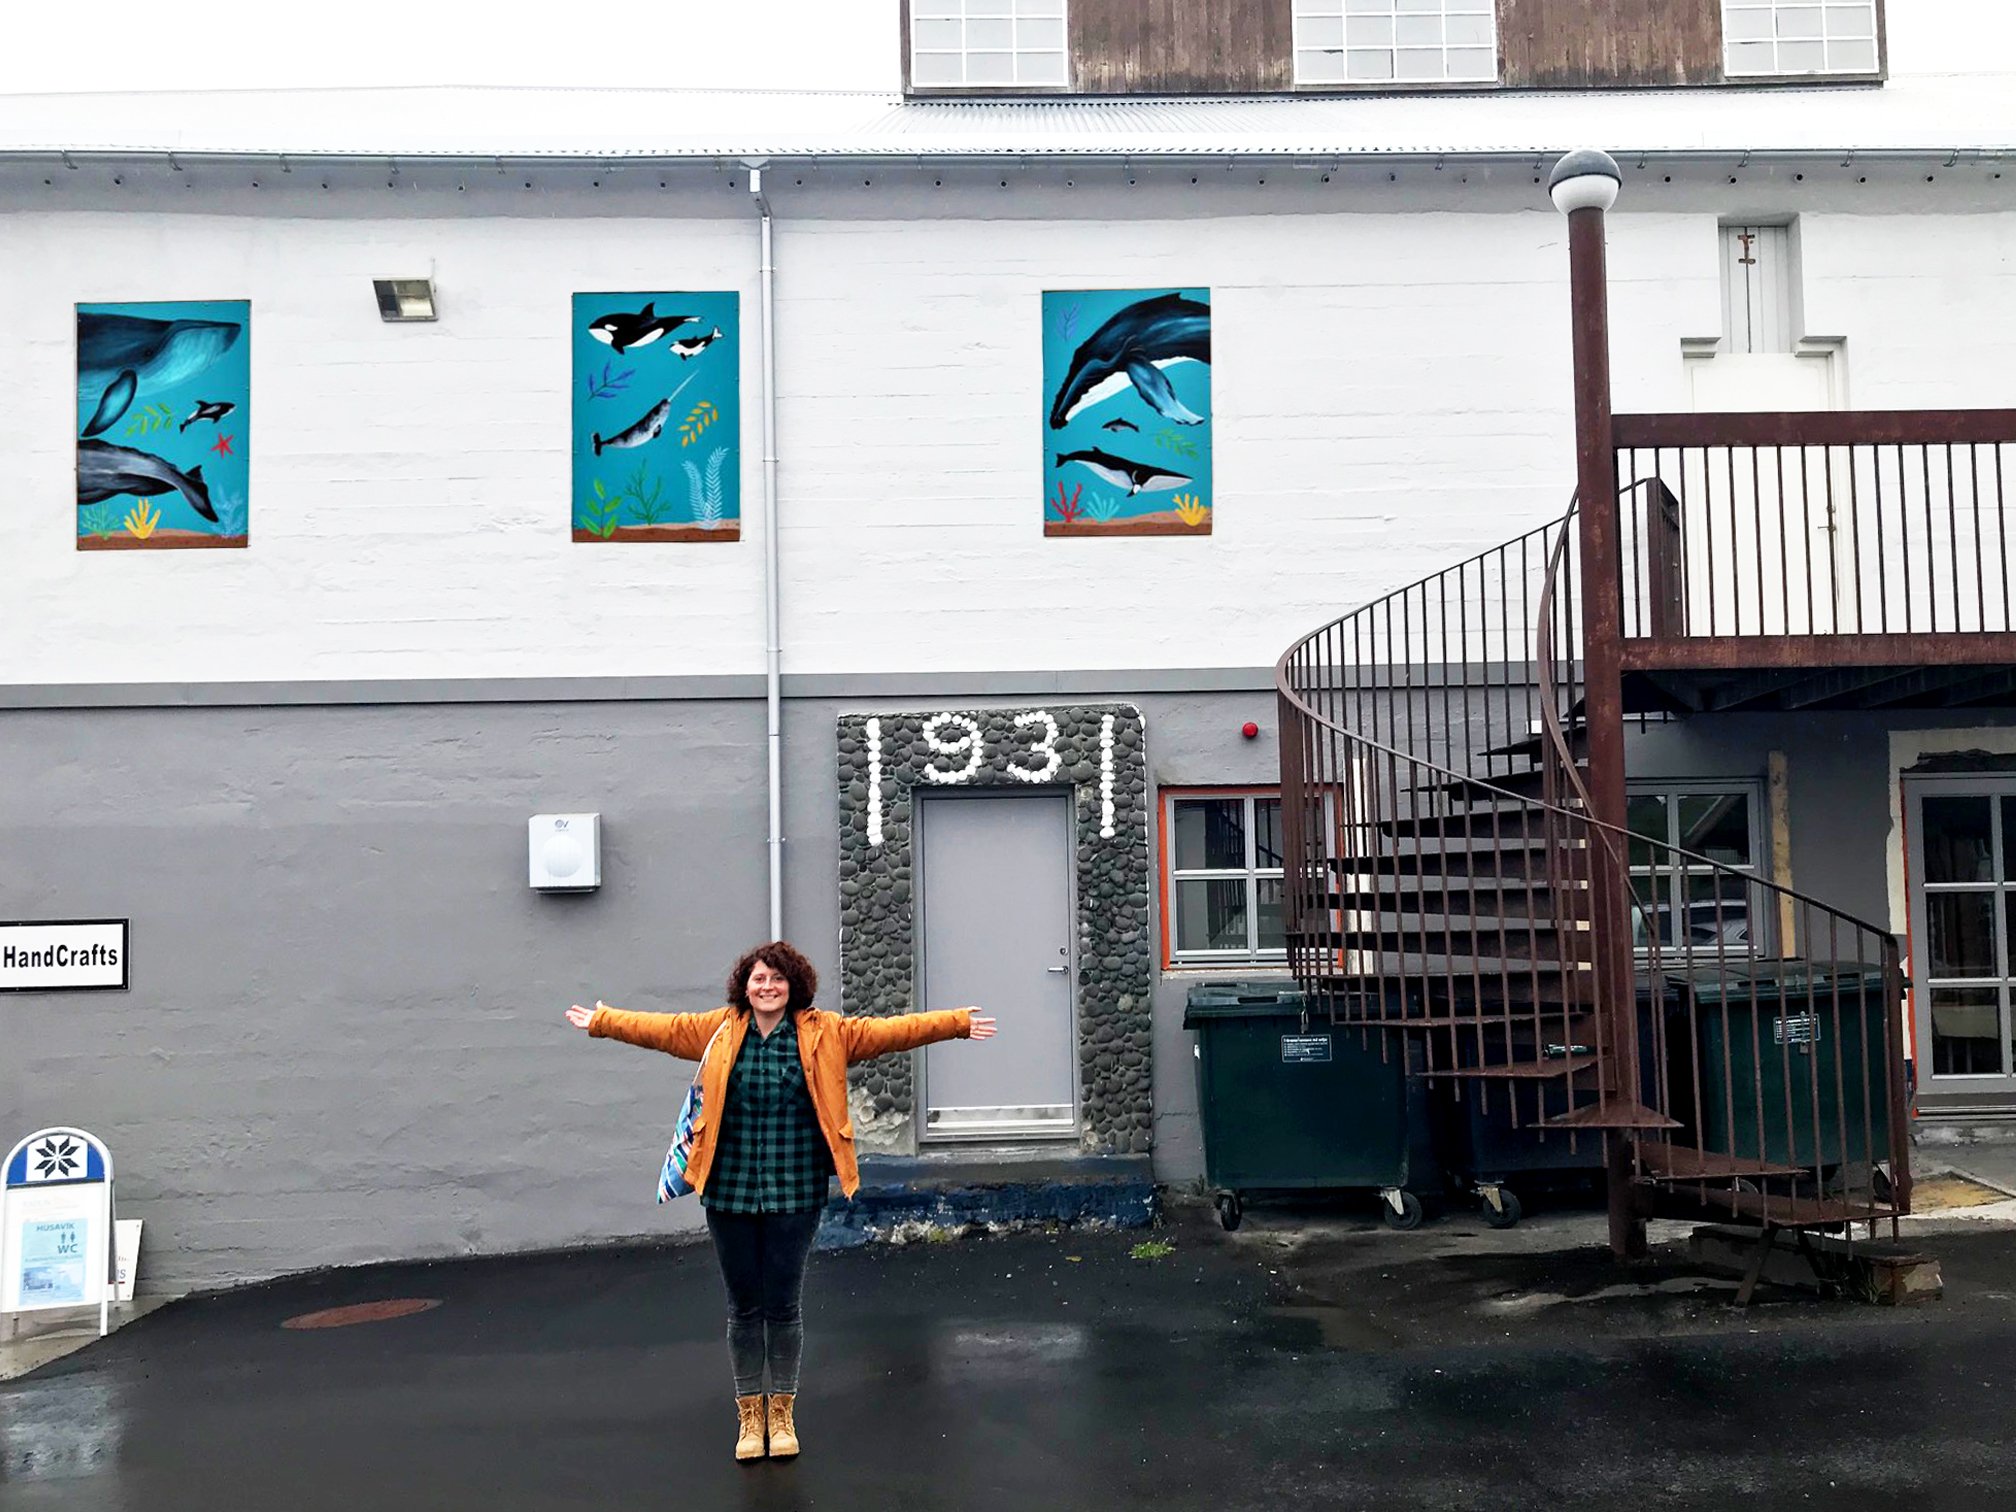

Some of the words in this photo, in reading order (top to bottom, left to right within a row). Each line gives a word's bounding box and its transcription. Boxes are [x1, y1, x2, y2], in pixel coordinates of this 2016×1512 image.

[866, 711, 1115, 846] 1931
[3, 943, 118, 968] HandCrafts
[57, 1243, 78, 1254] WC
